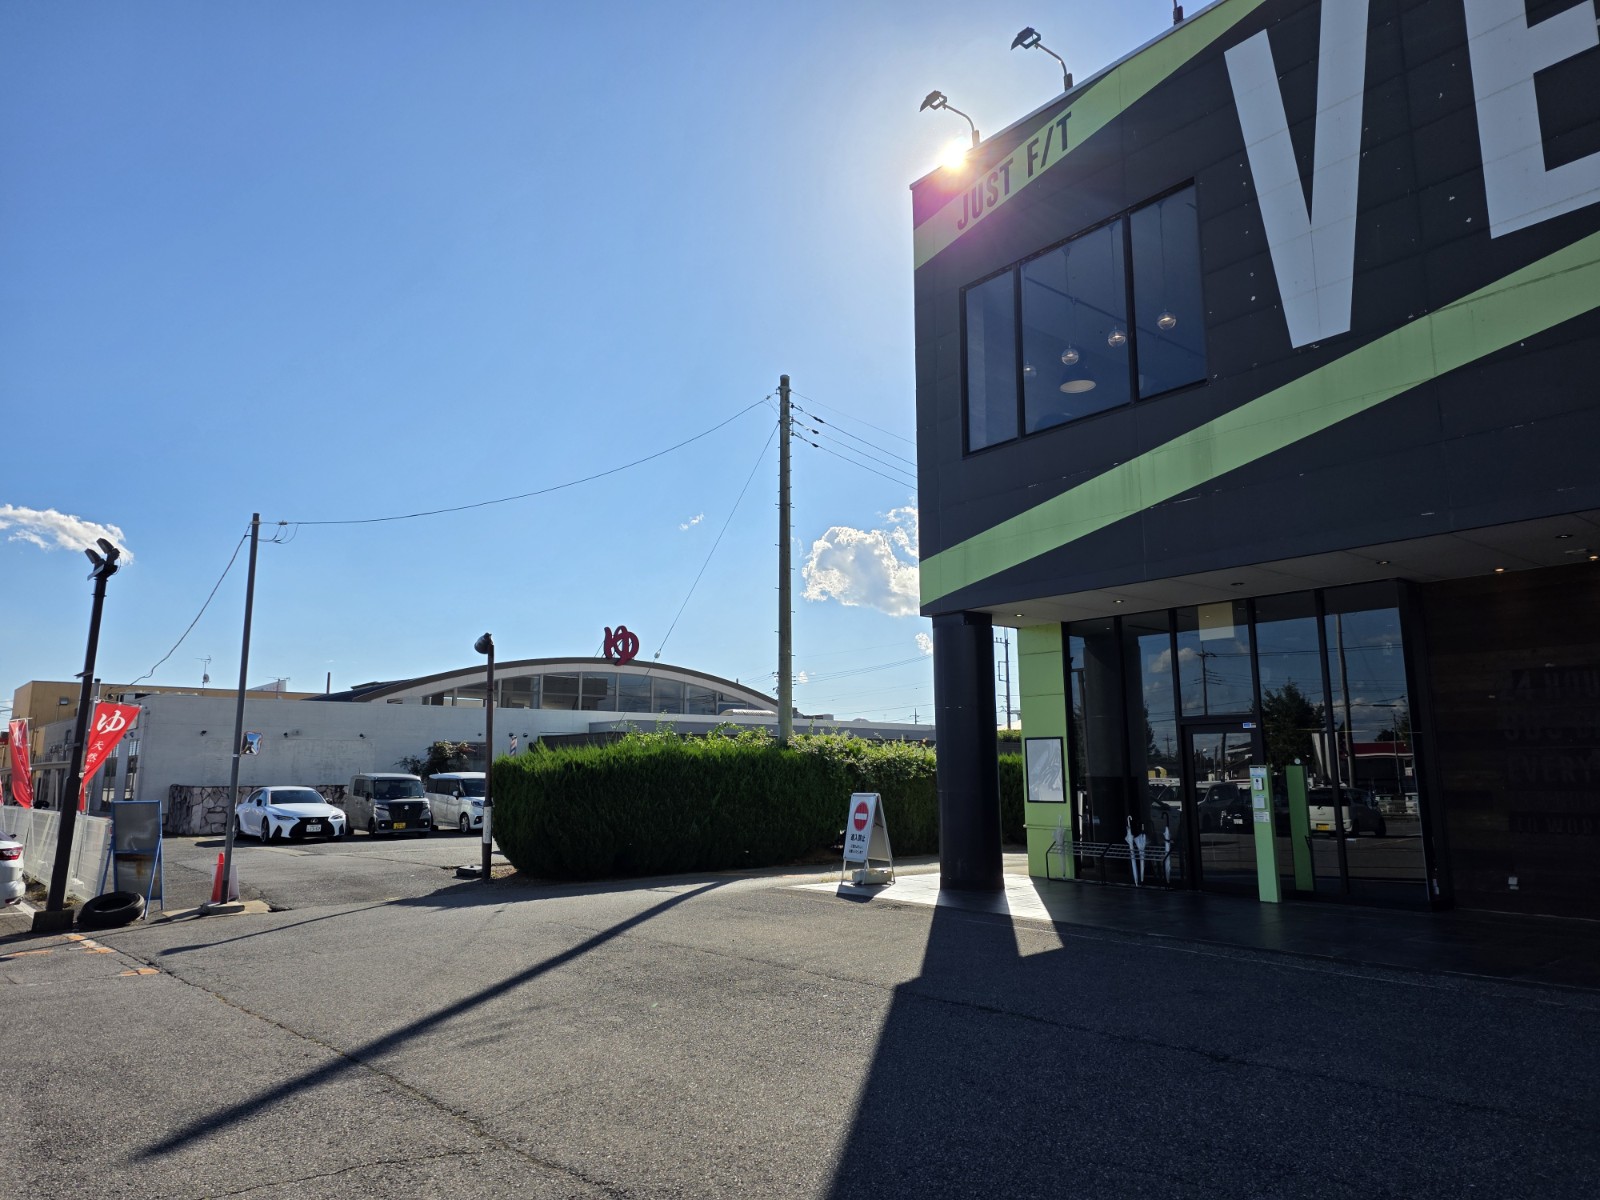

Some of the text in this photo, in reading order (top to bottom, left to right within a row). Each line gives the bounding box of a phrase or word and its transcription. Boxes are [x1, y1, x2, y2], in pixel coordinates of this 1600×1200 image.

[957, 111, 1072, 231] JUST F/T
[604, 625, 640, 666] ゆ
[96, 709, 126, 734] ゆ
